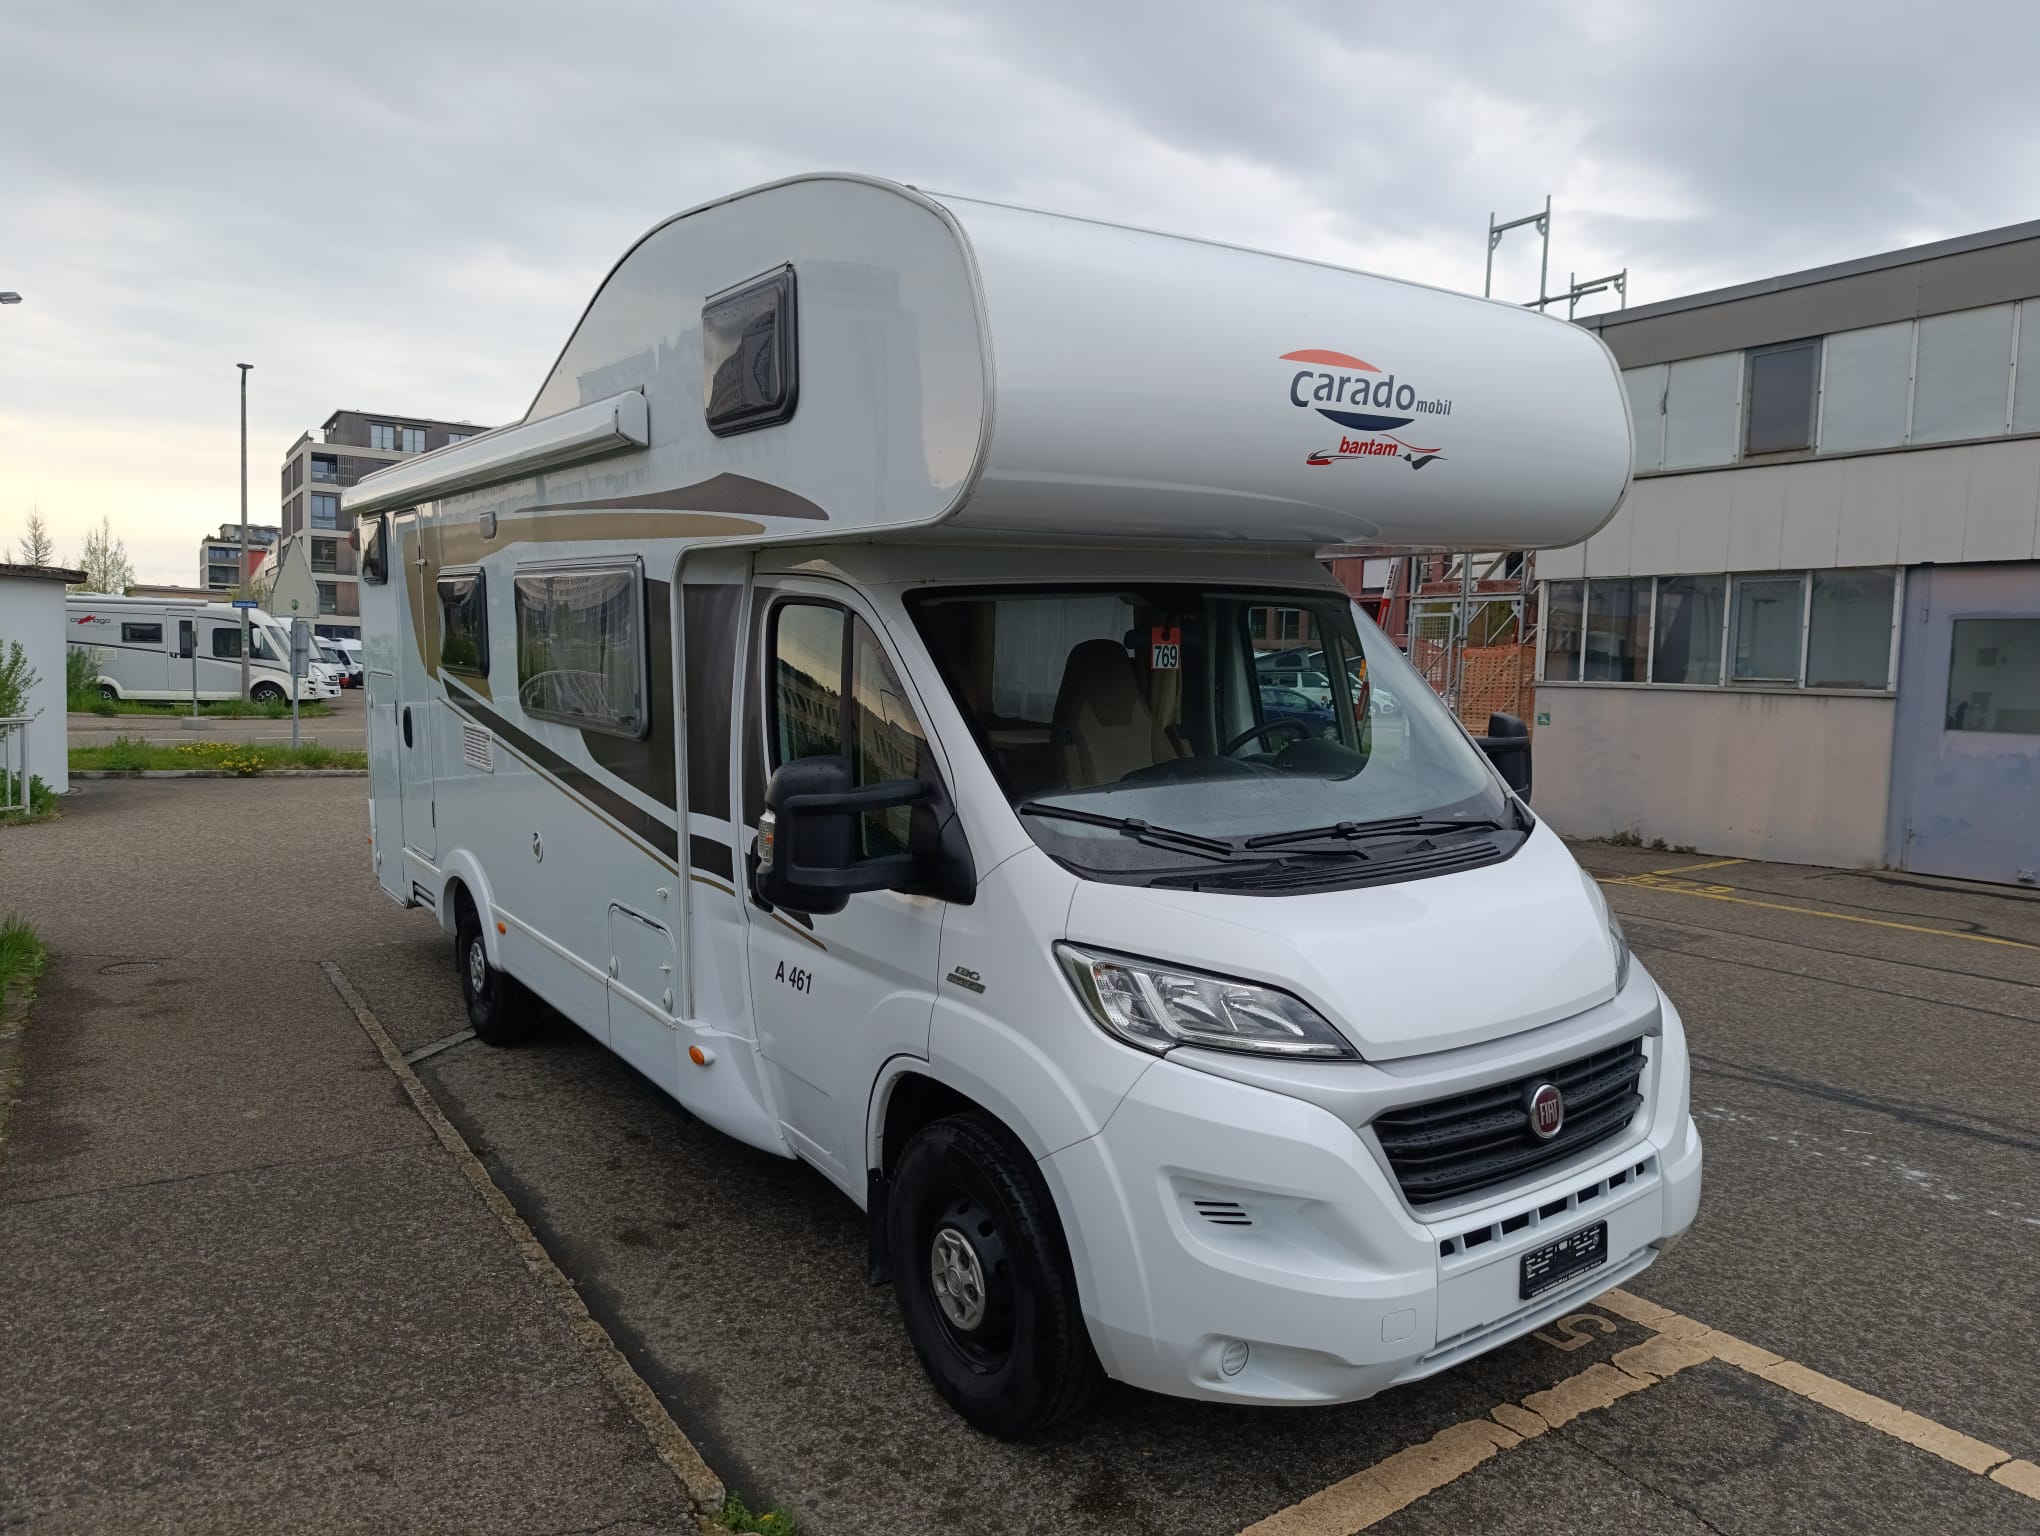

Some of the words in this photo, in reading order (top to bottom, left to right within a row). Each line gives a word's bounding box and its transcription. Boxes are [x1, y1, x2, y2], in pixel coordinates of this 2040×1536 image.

[1290, 370, 1415, 411] Carado
[1416, 399, 1452, 416] mobil
[1338, 436, 1398, 456] bantam
[1154, 645, 1178, 668] 769
[775, 960, 785, 983] A
[790, 966, 812, 994] 461
[1539, 1098, 1558, 1126] FIAT
